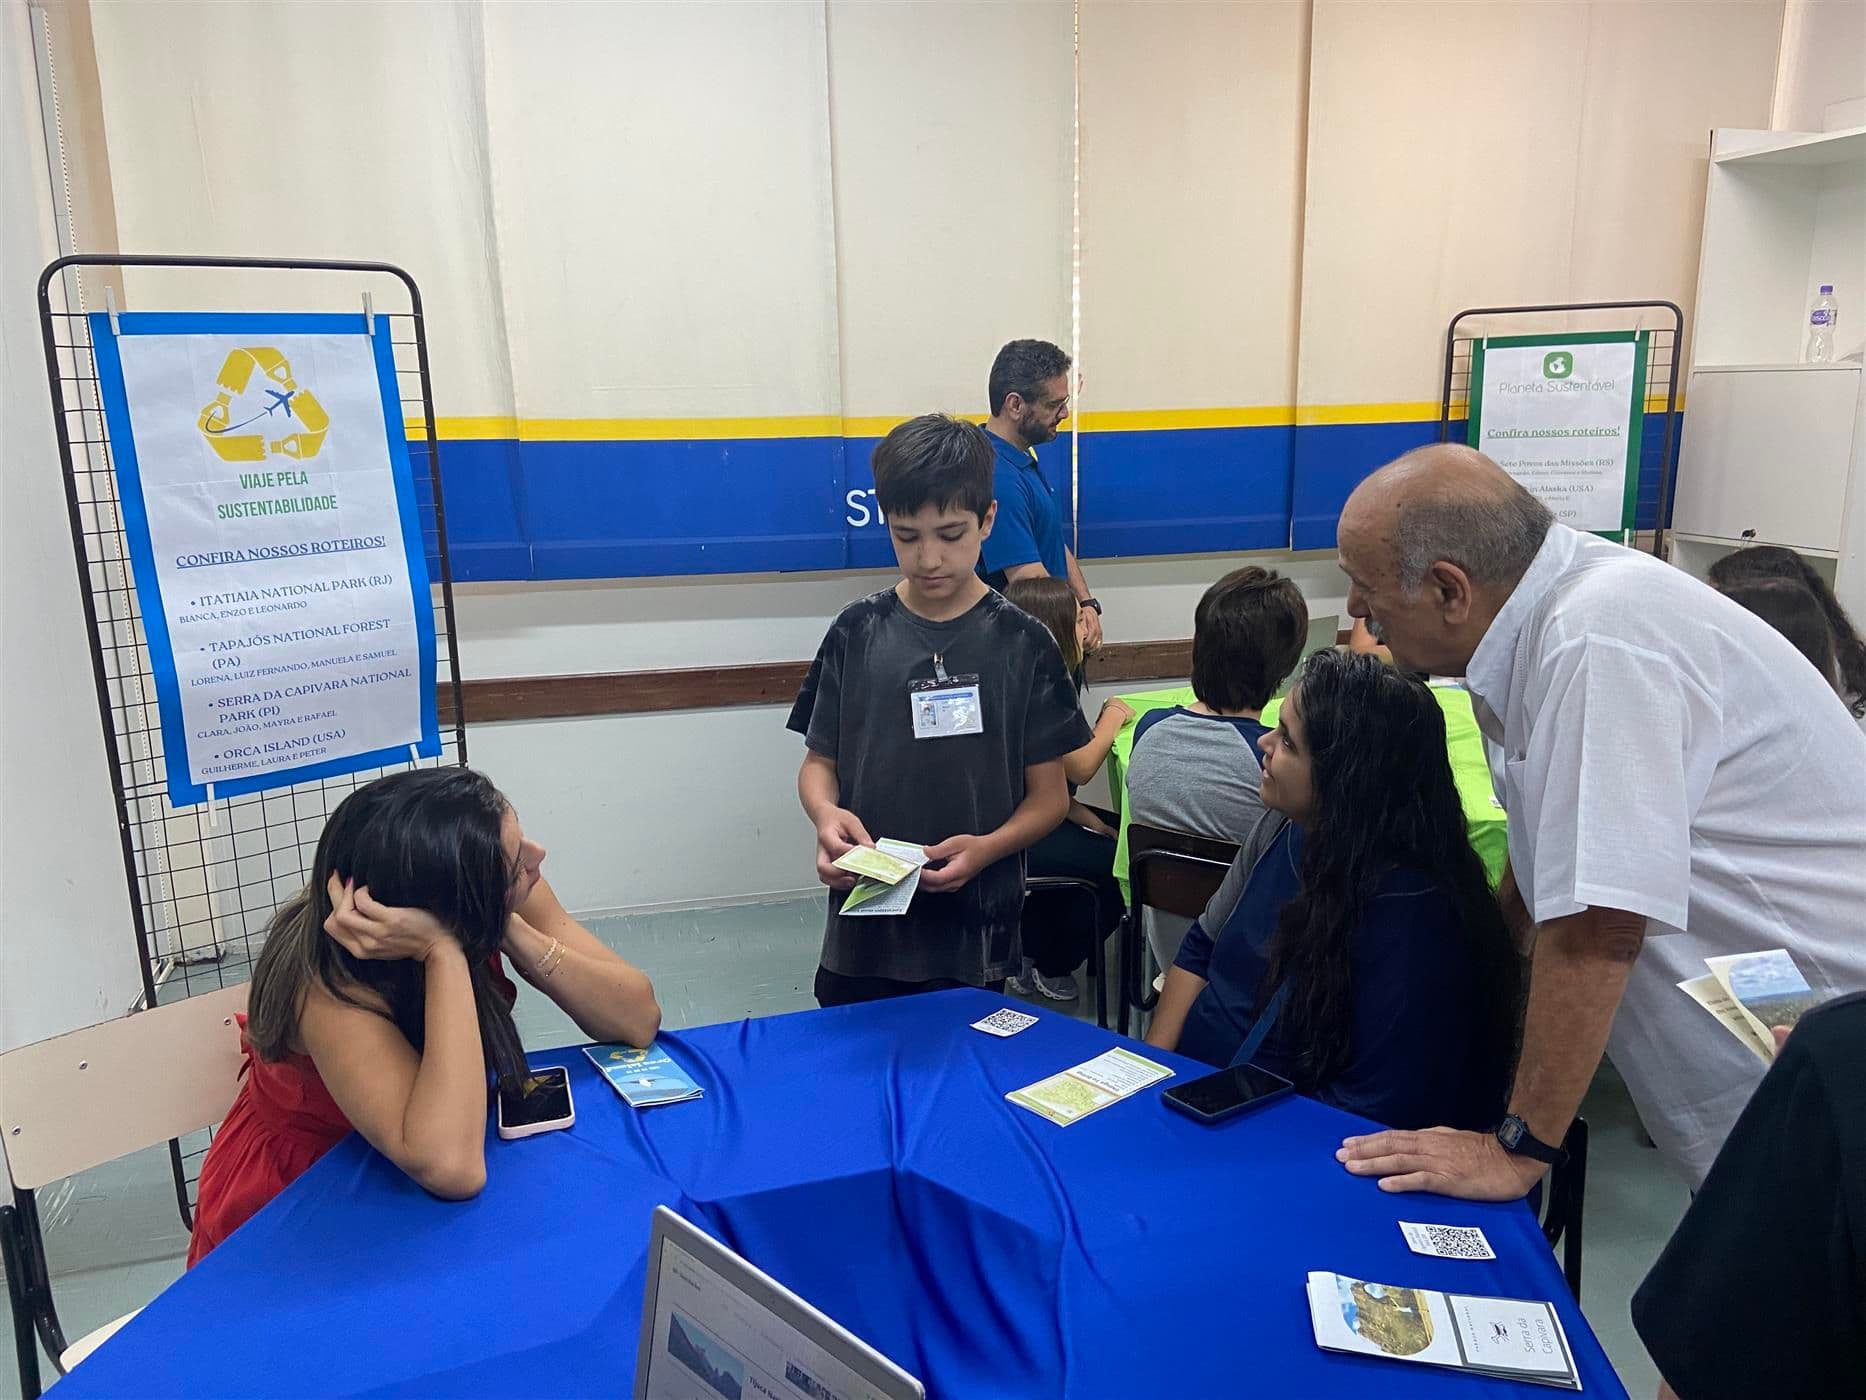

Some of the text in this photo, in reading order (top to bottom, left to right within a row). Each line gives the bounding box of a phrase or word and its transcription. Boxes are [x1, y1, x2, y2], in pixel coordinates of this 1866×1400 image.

[1498, 382, 1543, 393] Planeta
[1487, 425, 1620, 438] Confira nossos roteiros!
[1544, 459, 1559, 467] das
[239, 470, 309, 490] VIAJE PELA
[217, 495, 337, 520] SUSTENTABILIDADE
[176, 536, 385, 569] CONFIRA NOSSOS ROTEIROS!
[200, 574, 393, 607] ITATIAIA NATIONAL PARK (RJ)
[179, 600, 307, 624] BIANCA, ENZO E LEONARDO
[208, 619, 391, 653] TAPAJÓS NATIONAL FOREST
[191, 649, 398, 687] LORENA, LUIZ FERNANDO, MANUELA E SAMUEL
[212, 656, 241, 670] (PA)
[217, 668, 412, 708] SERRA DA CAPIVARA NATIONAL
[197, 728, 232, 739] CLARA,
[233, 723, 261, 734] JOÃO,
[263, 718, 296, 729] MAYRA
[304, 710, 337, 722] RAFAEL
[219, 705, 281, 724] PARK (PI)
[223, 728, 347, 760] ORCA ISLAND (USA)
[201, 760, 260, 775] GUILHERME,
[261, 753, 292, 766] LAURA
[299, 747, 327, 759] PETER
[1517, 1318, 1536, 1353] Serra da
[1535, 1319, 1554, 1354] Capivara
